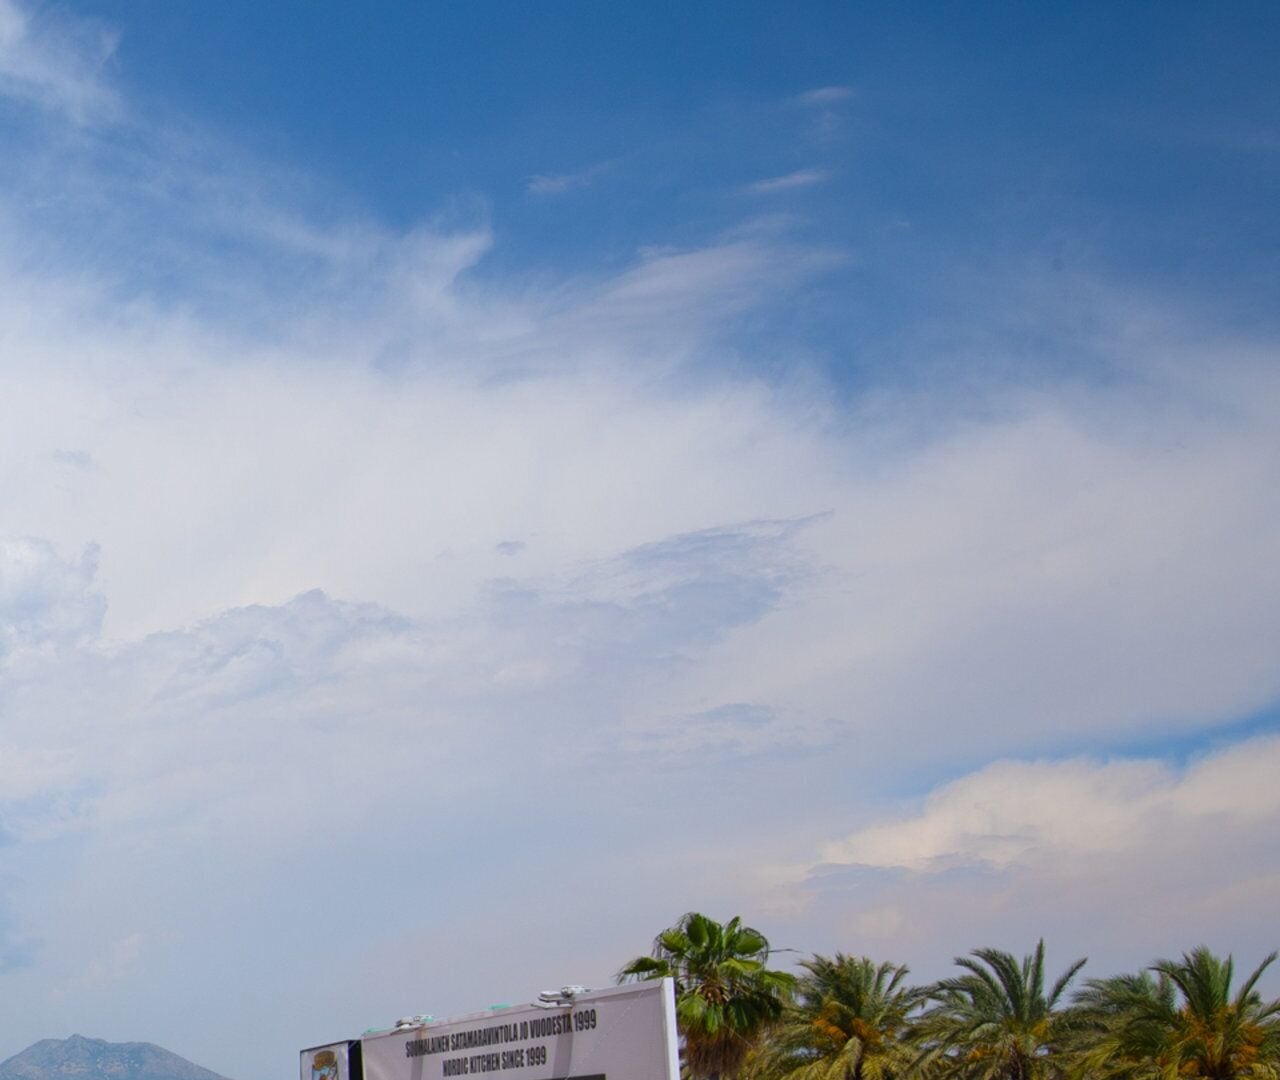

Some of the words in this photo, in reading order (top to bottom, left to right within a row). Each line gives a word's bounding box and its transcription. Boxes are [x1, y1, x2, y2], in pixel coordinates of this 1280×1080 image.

[451, 1023, 517, 1051] SATAMARAVINTOLA
[519, 1022, 528, 1040] JO
[530, 1013, 572, 1039] VUODESTA
[573, 1009, 597, 1031] 1999
[443, 1057, 469, 1077] NORDIC
[470, 1053, 500, 1074] KITCHEN
[502, 1050, 524, 1070] SINCE
[526, 1047, 547, 1066] 1999
